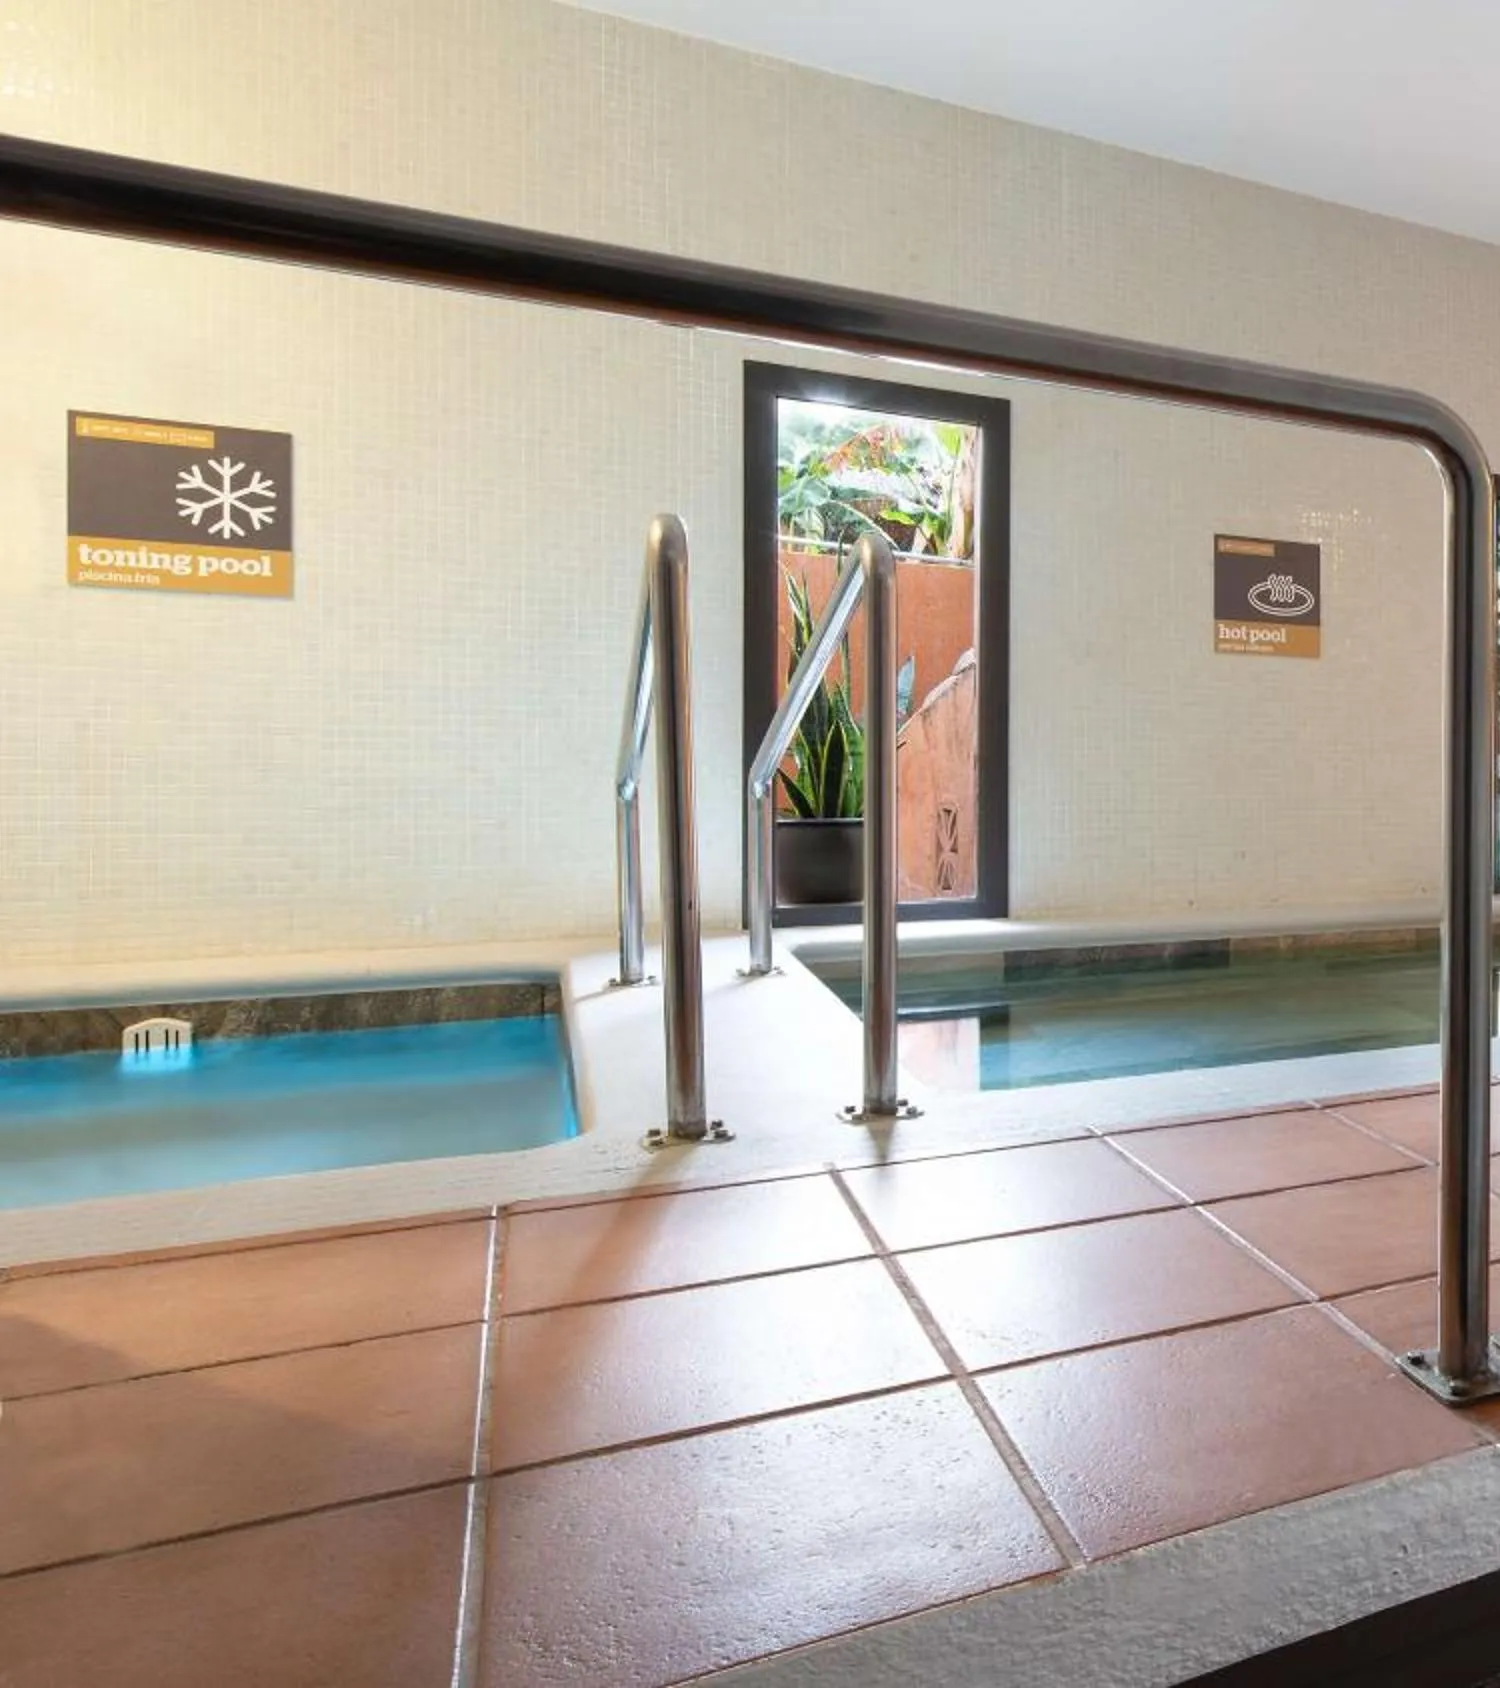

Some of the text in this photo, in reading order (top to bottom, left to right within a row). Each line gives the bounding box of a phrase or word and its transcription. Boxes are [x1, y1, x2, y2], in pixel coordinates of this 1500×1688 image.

[79, 543, 272, 577] toning pool
[1218, 624, 1287, 643] hot pool
